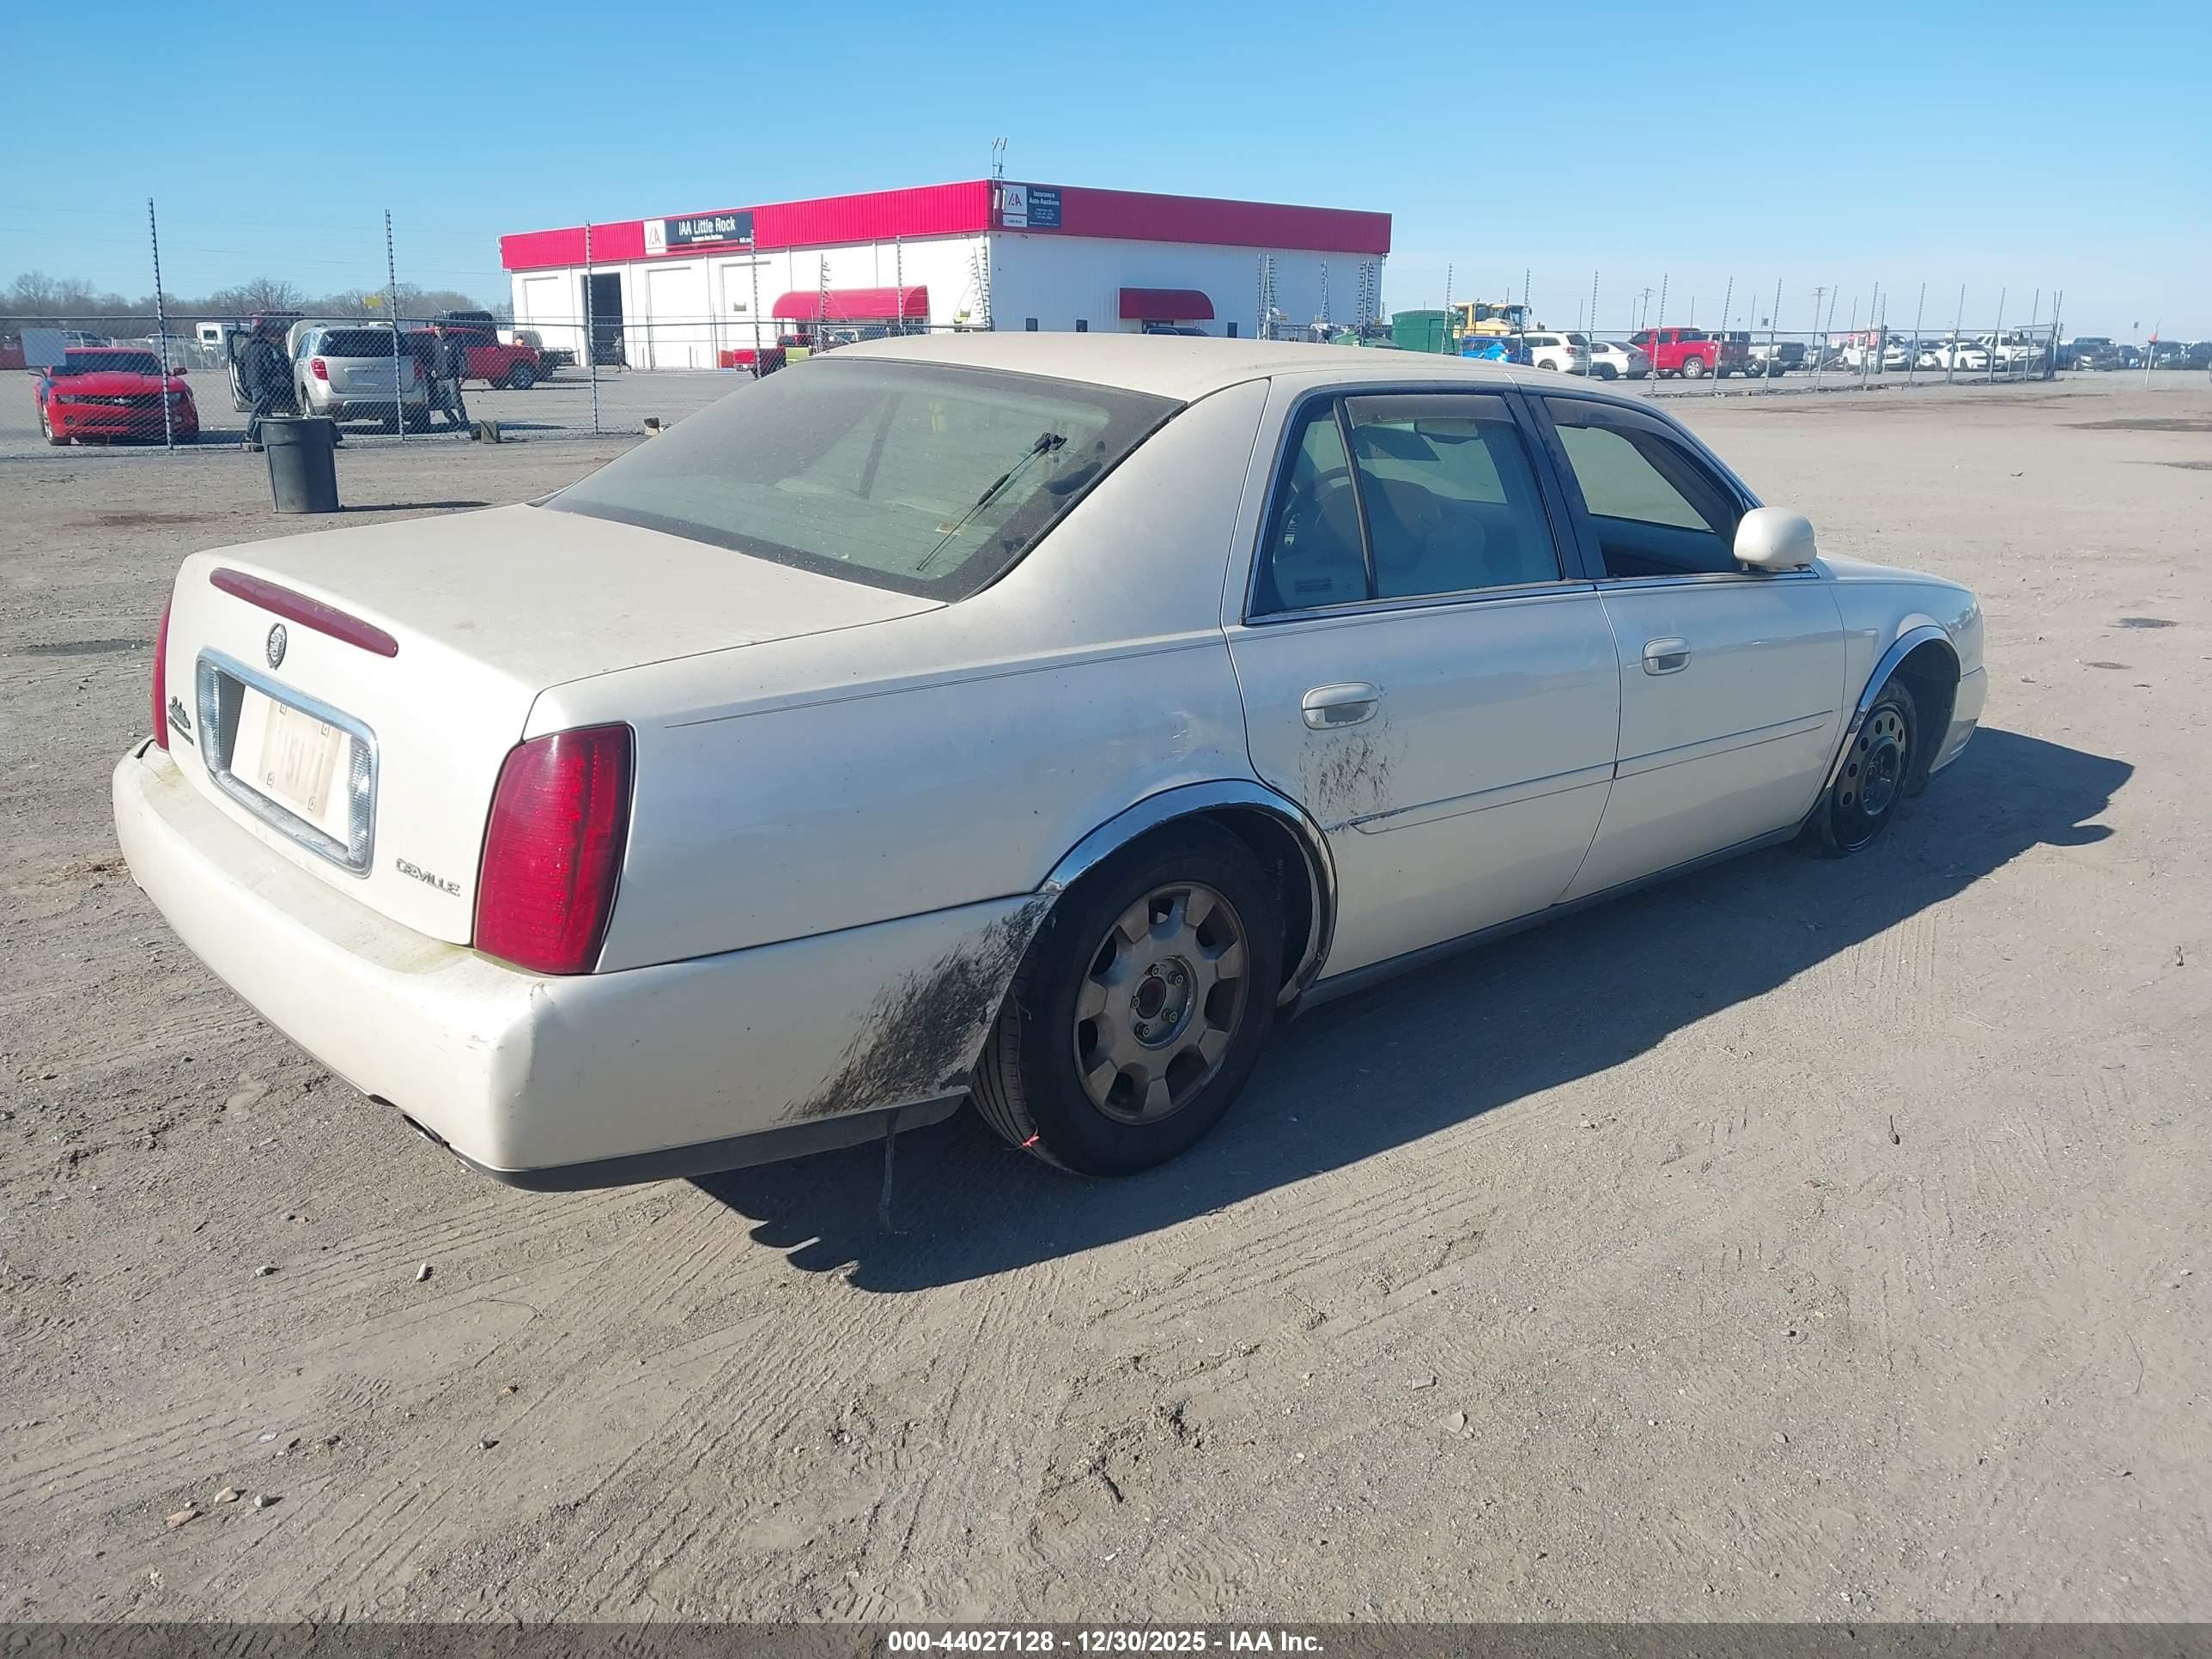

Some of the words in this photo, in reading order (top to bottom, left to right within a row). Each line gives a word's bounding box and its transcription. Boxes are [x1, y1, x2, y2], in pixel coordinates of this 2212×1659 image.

[678, 221, 692, 236] IAA
[693, 218, 713, 234] Little
[715, 216, 736, 232] Rock
